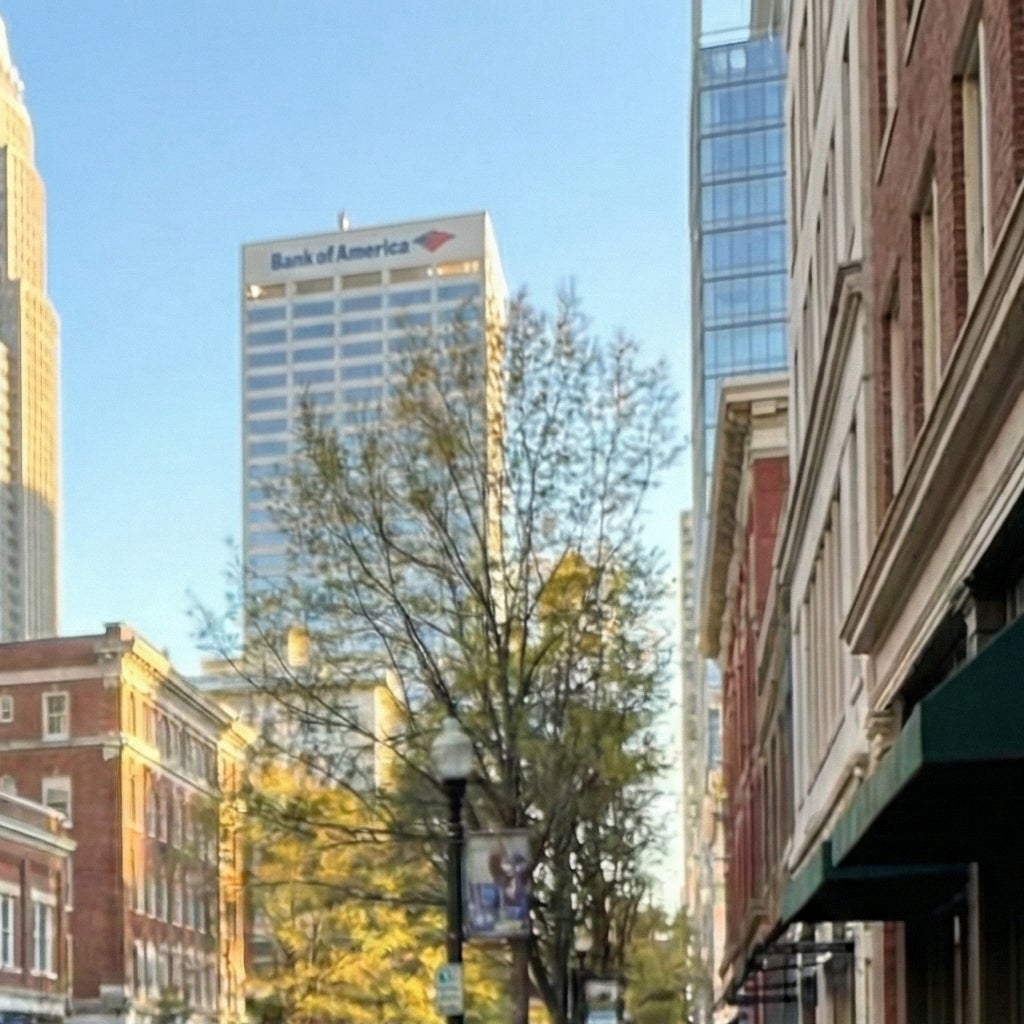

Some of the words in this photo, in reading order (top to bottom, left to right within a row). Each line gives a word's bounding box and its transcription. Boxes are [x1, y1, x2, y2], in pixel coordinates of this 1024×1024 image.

[271, 249, 313, 271] Bank
[317, 245, 334, 264] of
[336, 238, 410, 262] America
